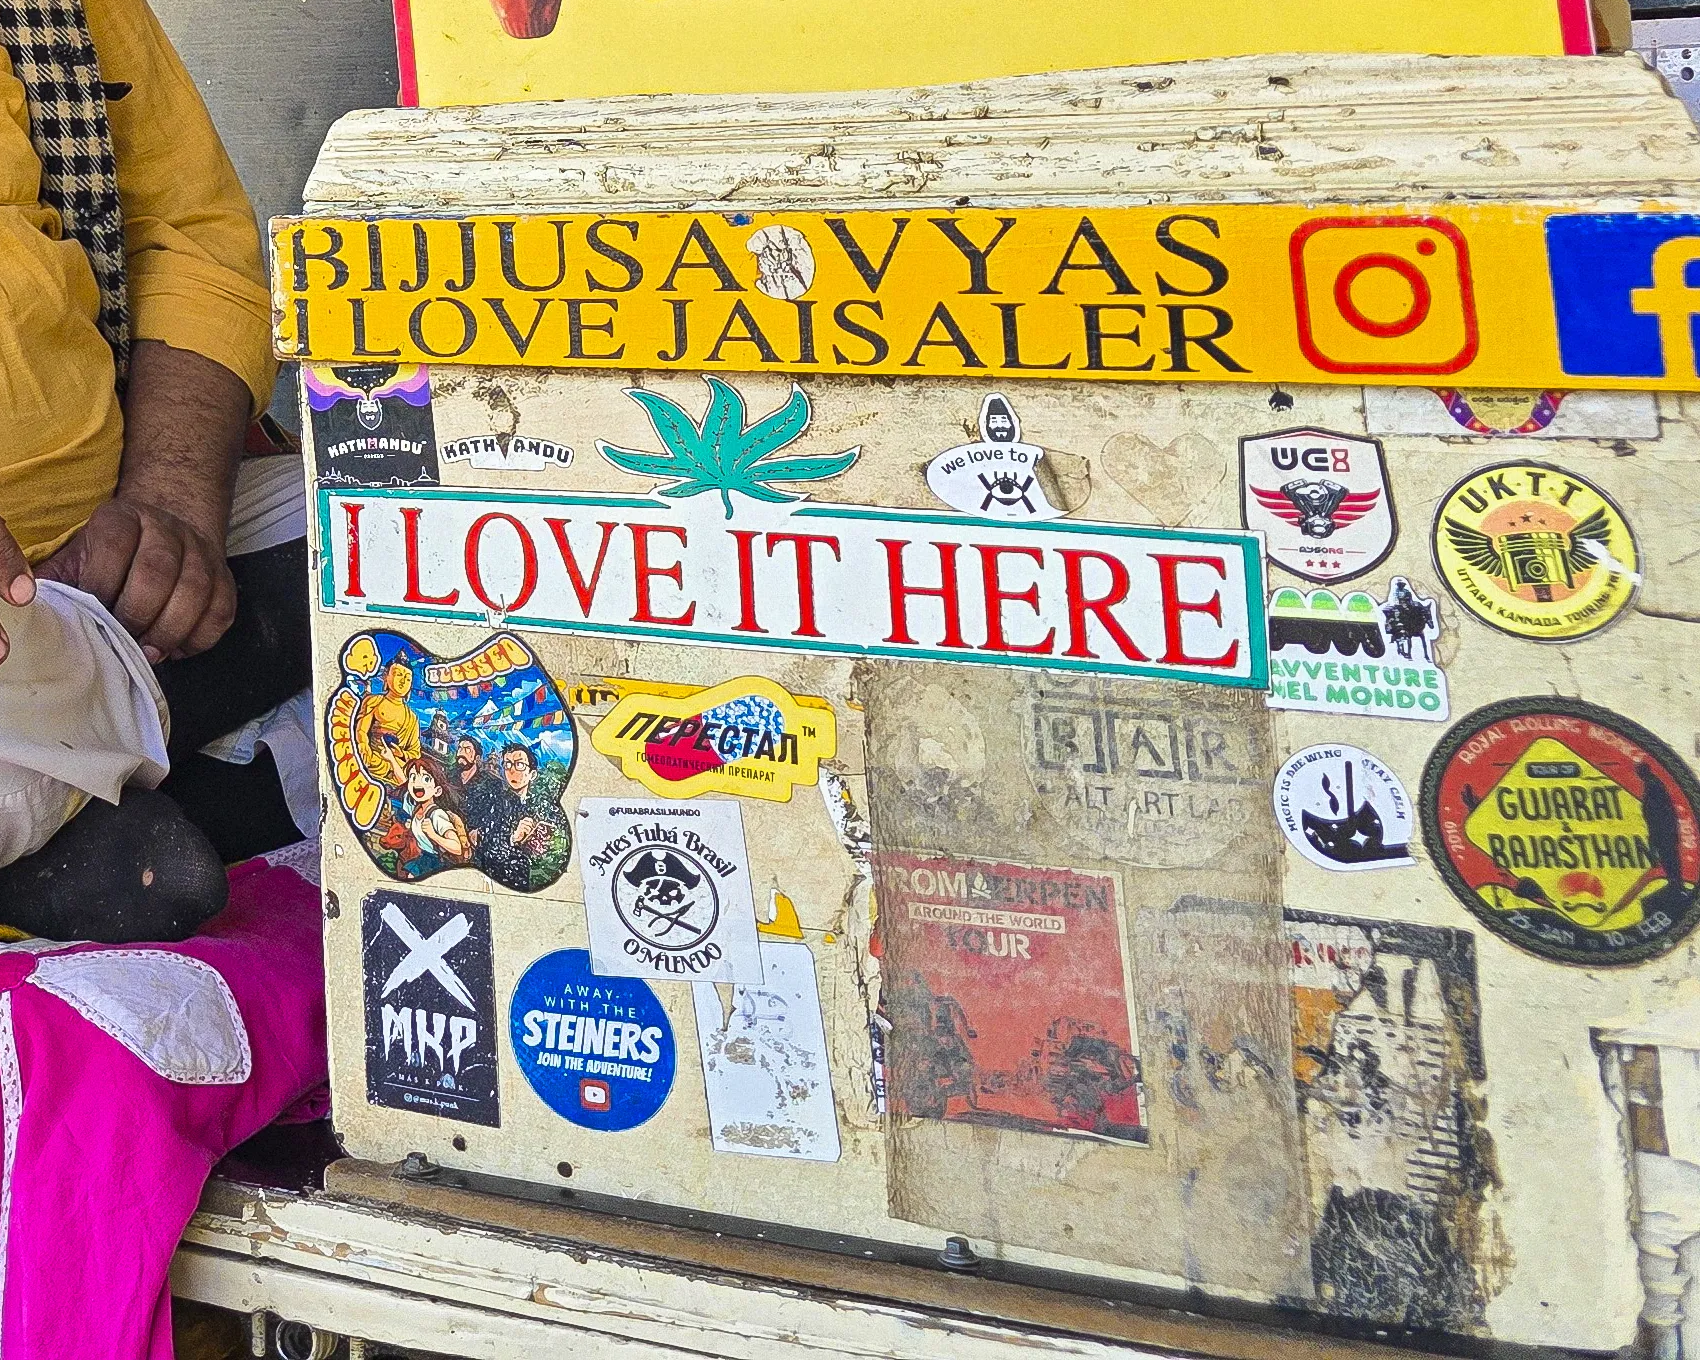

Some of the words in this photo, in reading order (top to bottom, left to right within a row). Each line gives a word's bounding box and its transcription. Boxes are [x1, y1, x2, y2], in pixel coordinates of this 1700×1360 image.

[293, 217, 748, 294] BIJJUSA
[823, 214, 1230, 297] VYAS
[295, 298, 313, 358] I
[347, 298, 625, 360] LOVE
[656, 298, 1252, 374] JAISALER
[327, 437, 424, 459] KATHMANDU
[444, 439, 570, 464] KATHANDU
[941, 455, 966, 475] we
[969, 444, 1003, 464] love
[1009, 449, 1028, 463] to
[342, 504, 365, 598] I
[402, 507, 696, 627] LOVE
[730, 529, 841, 638] IT
[877, 537, 1240, 668] HERE
[1457, 567, 1493, 610] UTTARA
[1497, 606, 1562, 627] KANNADA
[428, 637, 530, 683] BLESSED
[1271, 657, 1438, 689] AVVENTURE
[1325, 685, 1440, 712] MONDO
[616, 712, 799, 765] ПЕРЕСТАЛ
[1459, 726, 1506, 764] ROYAL
[729, 765, 775, 783] ПРЕПАРАТ
[1362, 759, 1392, 783] STAY
[1280, 794, 1297, 831] MAGIC
[1496, 786, 1623, 821] GUJARAT
[589, 834, 631, 876] Artes
[628, 823, 679, 845] Fubá
[683, 831, 737, 878] Brasil
[1487, 834, 1661, 870] RAJASTHAN
[913, 906, 972, 922] AROUND
[977, 911, 1004, 924] THE
[1010, 914, 1061, 930] WORLD
[637, 942, 722, 973] MUNDO
[544, 996, 589, 1012] WITH
[602, 1004, 636, 1019] THE
[381, 1003, 477, 1075] MKP
[523, 1010, 662, 1063] STEINERS
[537, 1052, 561, 1068] JOIN
[565, 1056, 583, 1071] THE
[586, 1059, 652, 1082] ADVENTURE!
